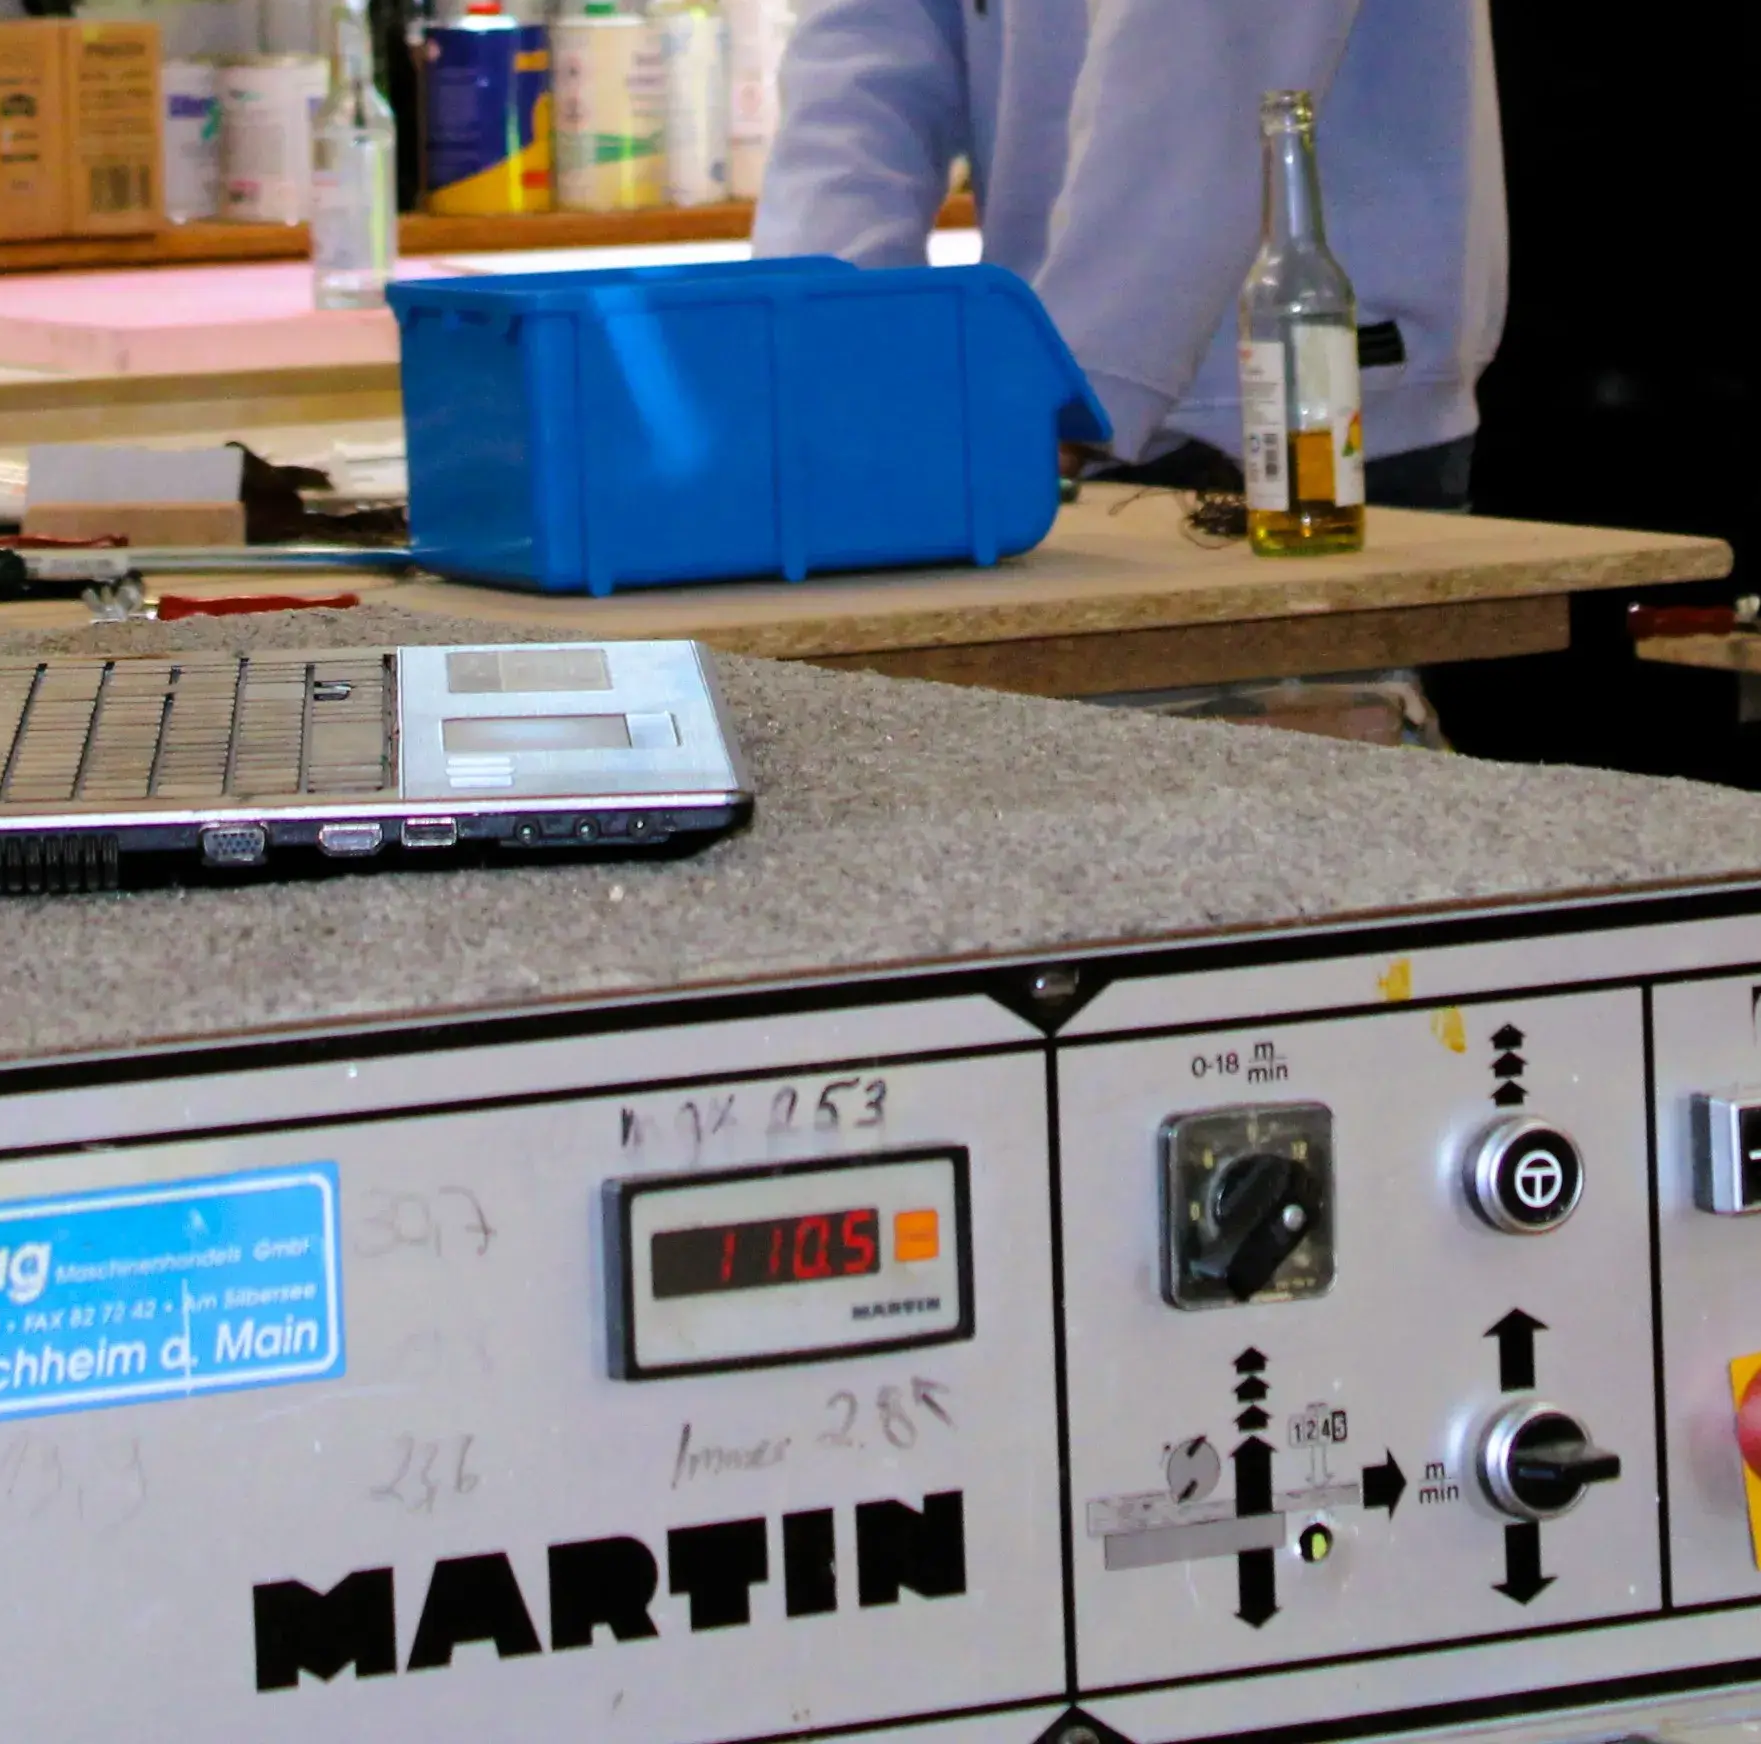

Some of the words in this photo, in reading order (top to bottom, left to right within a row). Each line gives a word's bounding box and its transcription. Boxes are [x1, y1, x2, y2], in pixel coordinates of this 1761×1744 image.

[1191, 1052, 1239, 1078] 0-18
[1247, 1060, 1288, 1084] min
[23, 1307, 65, 1334] FAX
[851, 1297, 941, 1321] MARTIN
[216, 1313, 320, 1363] Main
[1419, 1483, 1460, 1505] min
[252, 1490, 966, 1693] MARTIN
